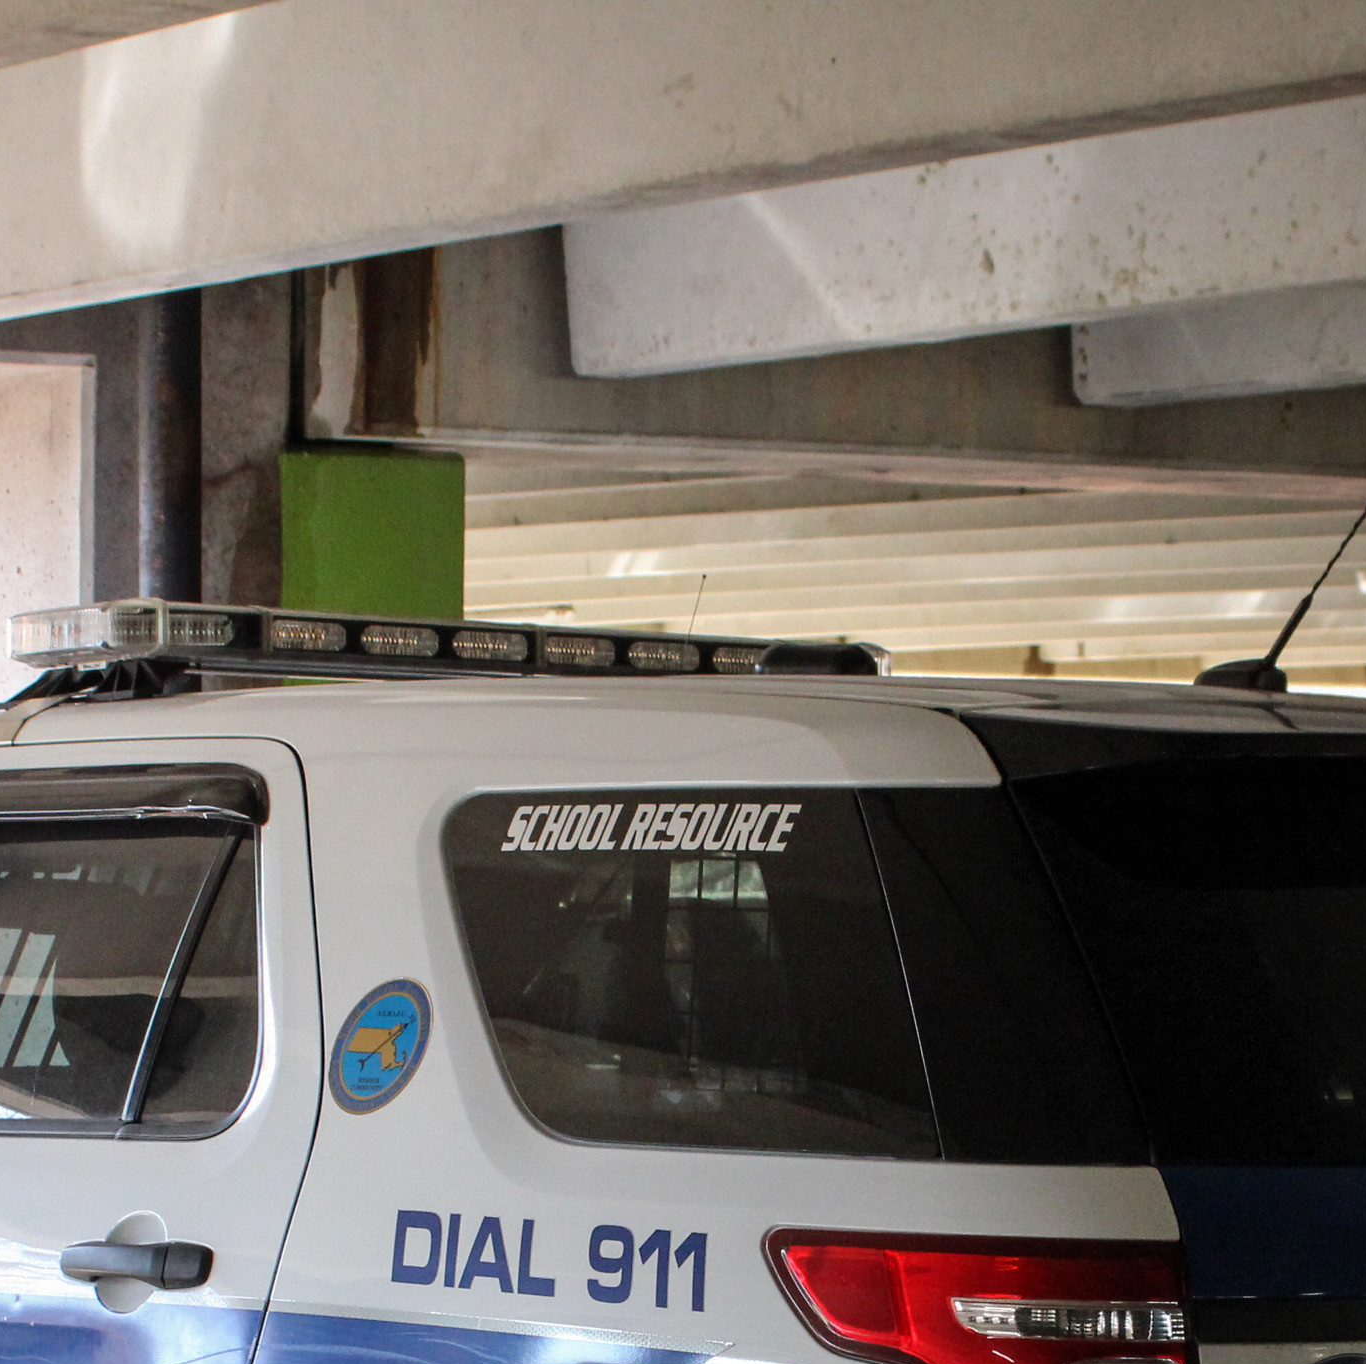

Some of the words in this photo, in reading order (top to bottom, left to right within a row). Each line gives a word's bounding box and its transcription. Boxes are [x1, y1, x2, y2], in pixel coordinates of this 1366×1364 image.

[500, 804, 624, 852] SCHOOL
[620, 803, 802, 852] RESOURCE
[391, 1209, 555, 1297] DIAL
[587, 1224, 708, 1312] 911
